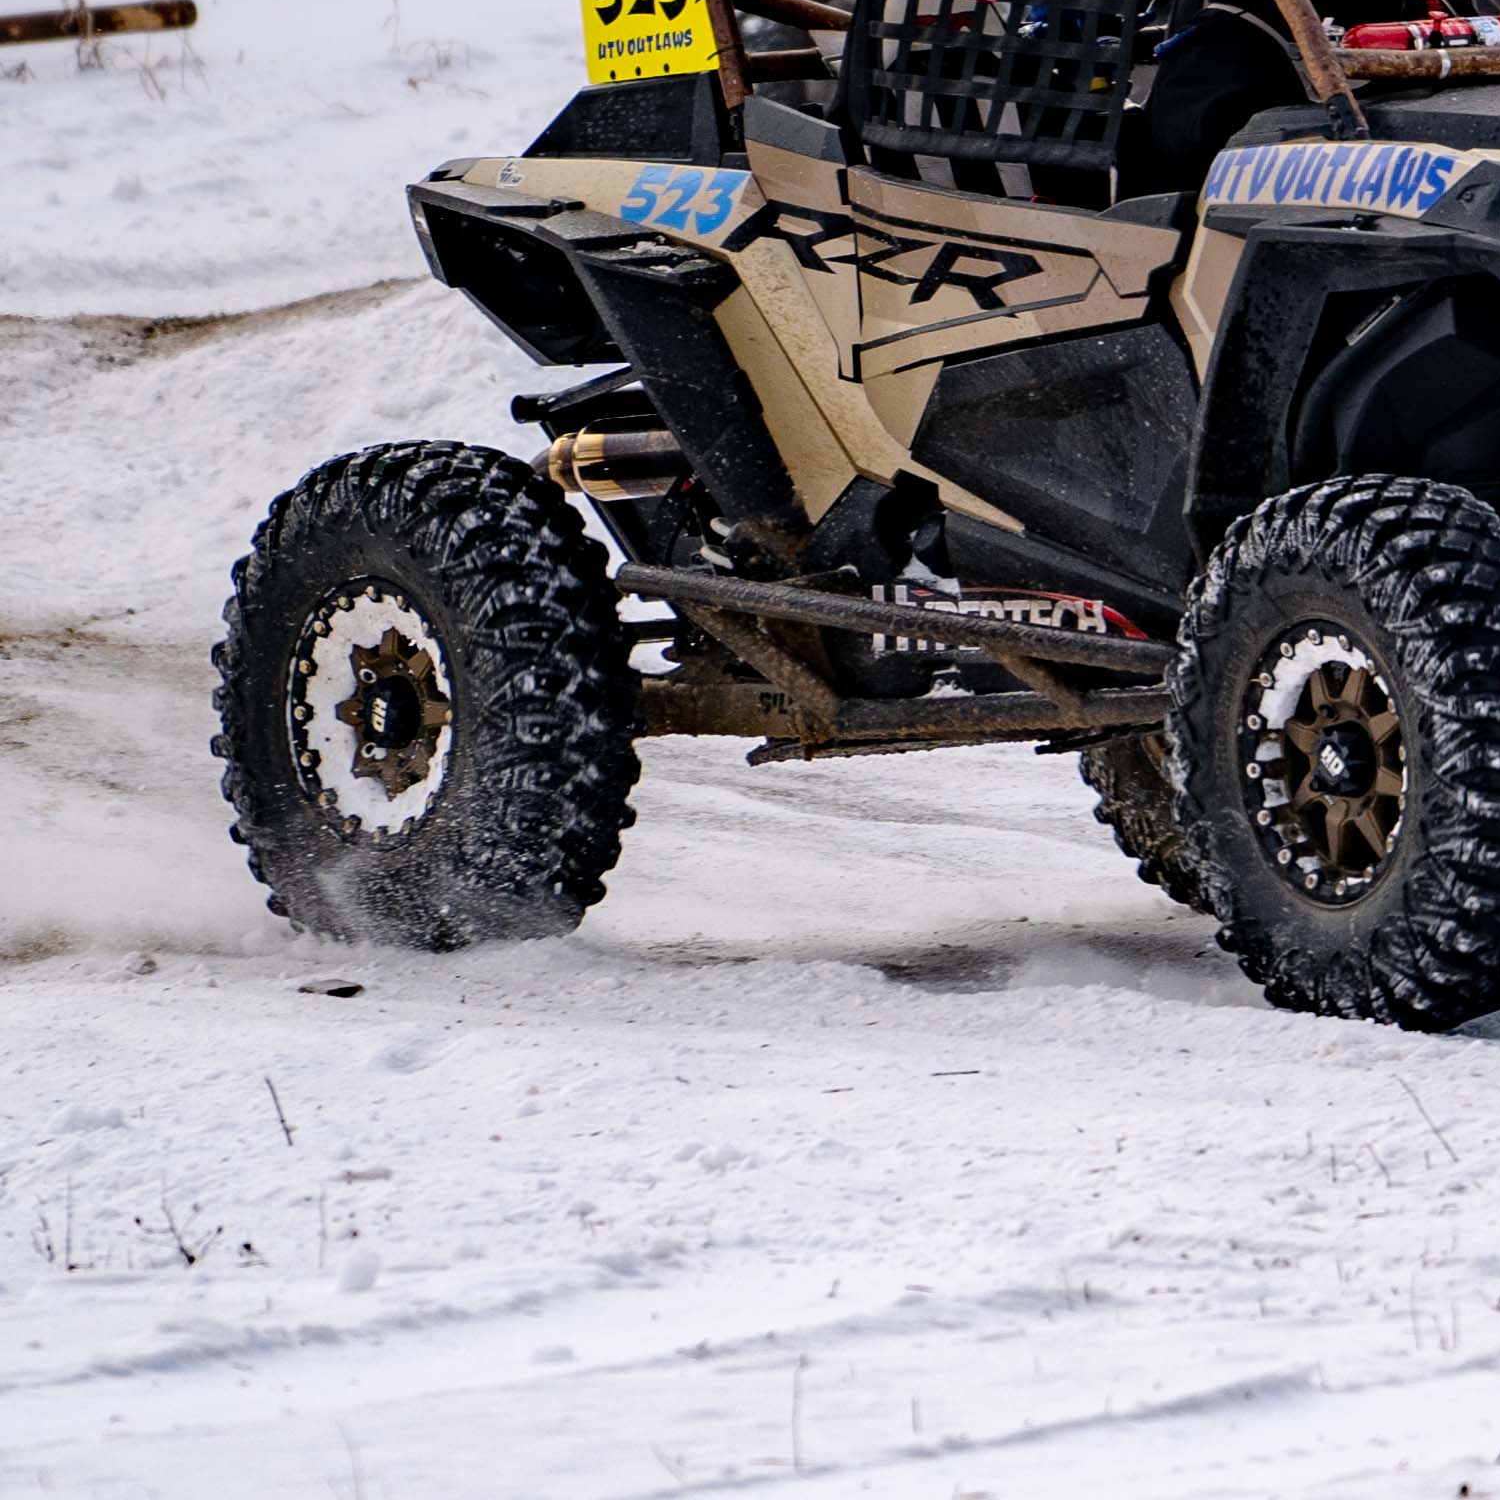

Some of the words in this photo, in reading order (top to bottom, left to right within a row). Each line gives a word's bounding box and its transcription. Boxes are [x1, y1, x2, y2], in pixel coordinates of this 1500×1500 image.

[598, 40, 625, 60] UTV
[627, 28, 694, 56] OUTLAWS
[619, 165, 752, 236] 523
[1203, 145, 1281, 203] UTV
[1273, 144, 1457, 212] OUTLAWS
[719, 198, 1044, 318] RZR
